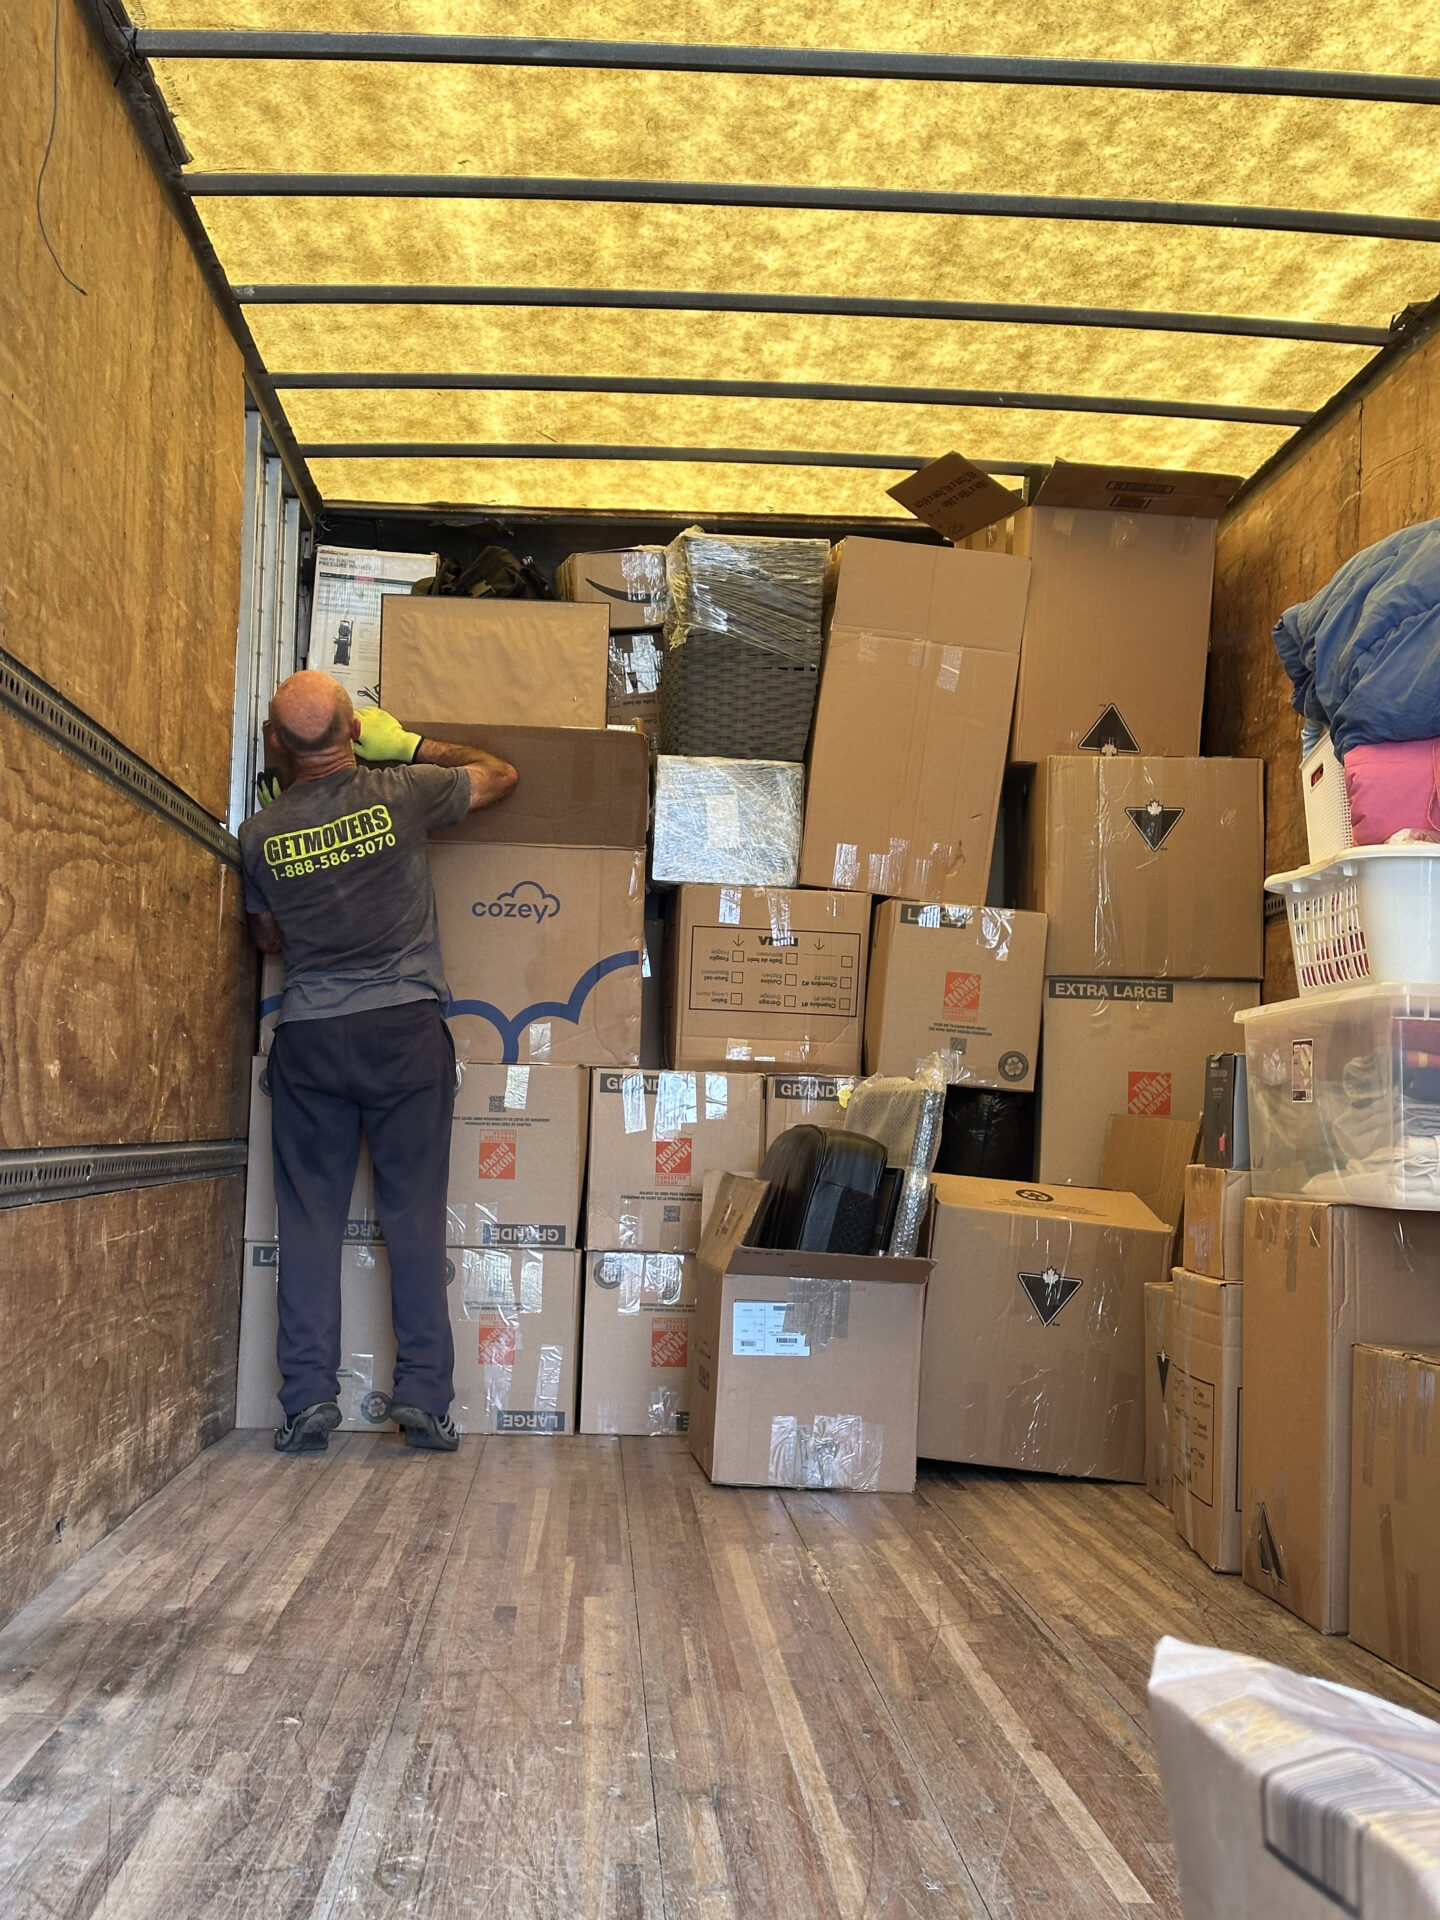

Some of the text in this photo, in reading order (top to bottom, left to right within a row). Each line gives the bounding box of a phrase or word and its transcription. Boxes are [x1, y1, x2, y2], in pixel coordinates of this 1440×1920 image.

[318, 560, 347, 569] PRESSURE
[265, 806, 391, 863] GETMOVERS
[271, 833, 396, 880] 1-888-586-3070
[471, 901, 549, 924] cozey
[944, 975, 980, 1007] HOME
[1055, 982, 1168, 999] EXTRA LARGE
[780, 1083, 839, 1098] GRAND
[1128, 1072, 1172, 1115] HOME
[1132, 1075, 1151, 1093] THE
[1145, 1089, 1172, 1115] DEPOT
[479, 1142, 510, 1173] DEPOT
[656, 1138, 683, 1164] HOME
[661, 1143, 692, 1173] DEPOT
[486, 1151, 516, 1179] HOME
[651, 1331, 688, 1366] HOME
[503, 1414, 559, 1428] LARGE
